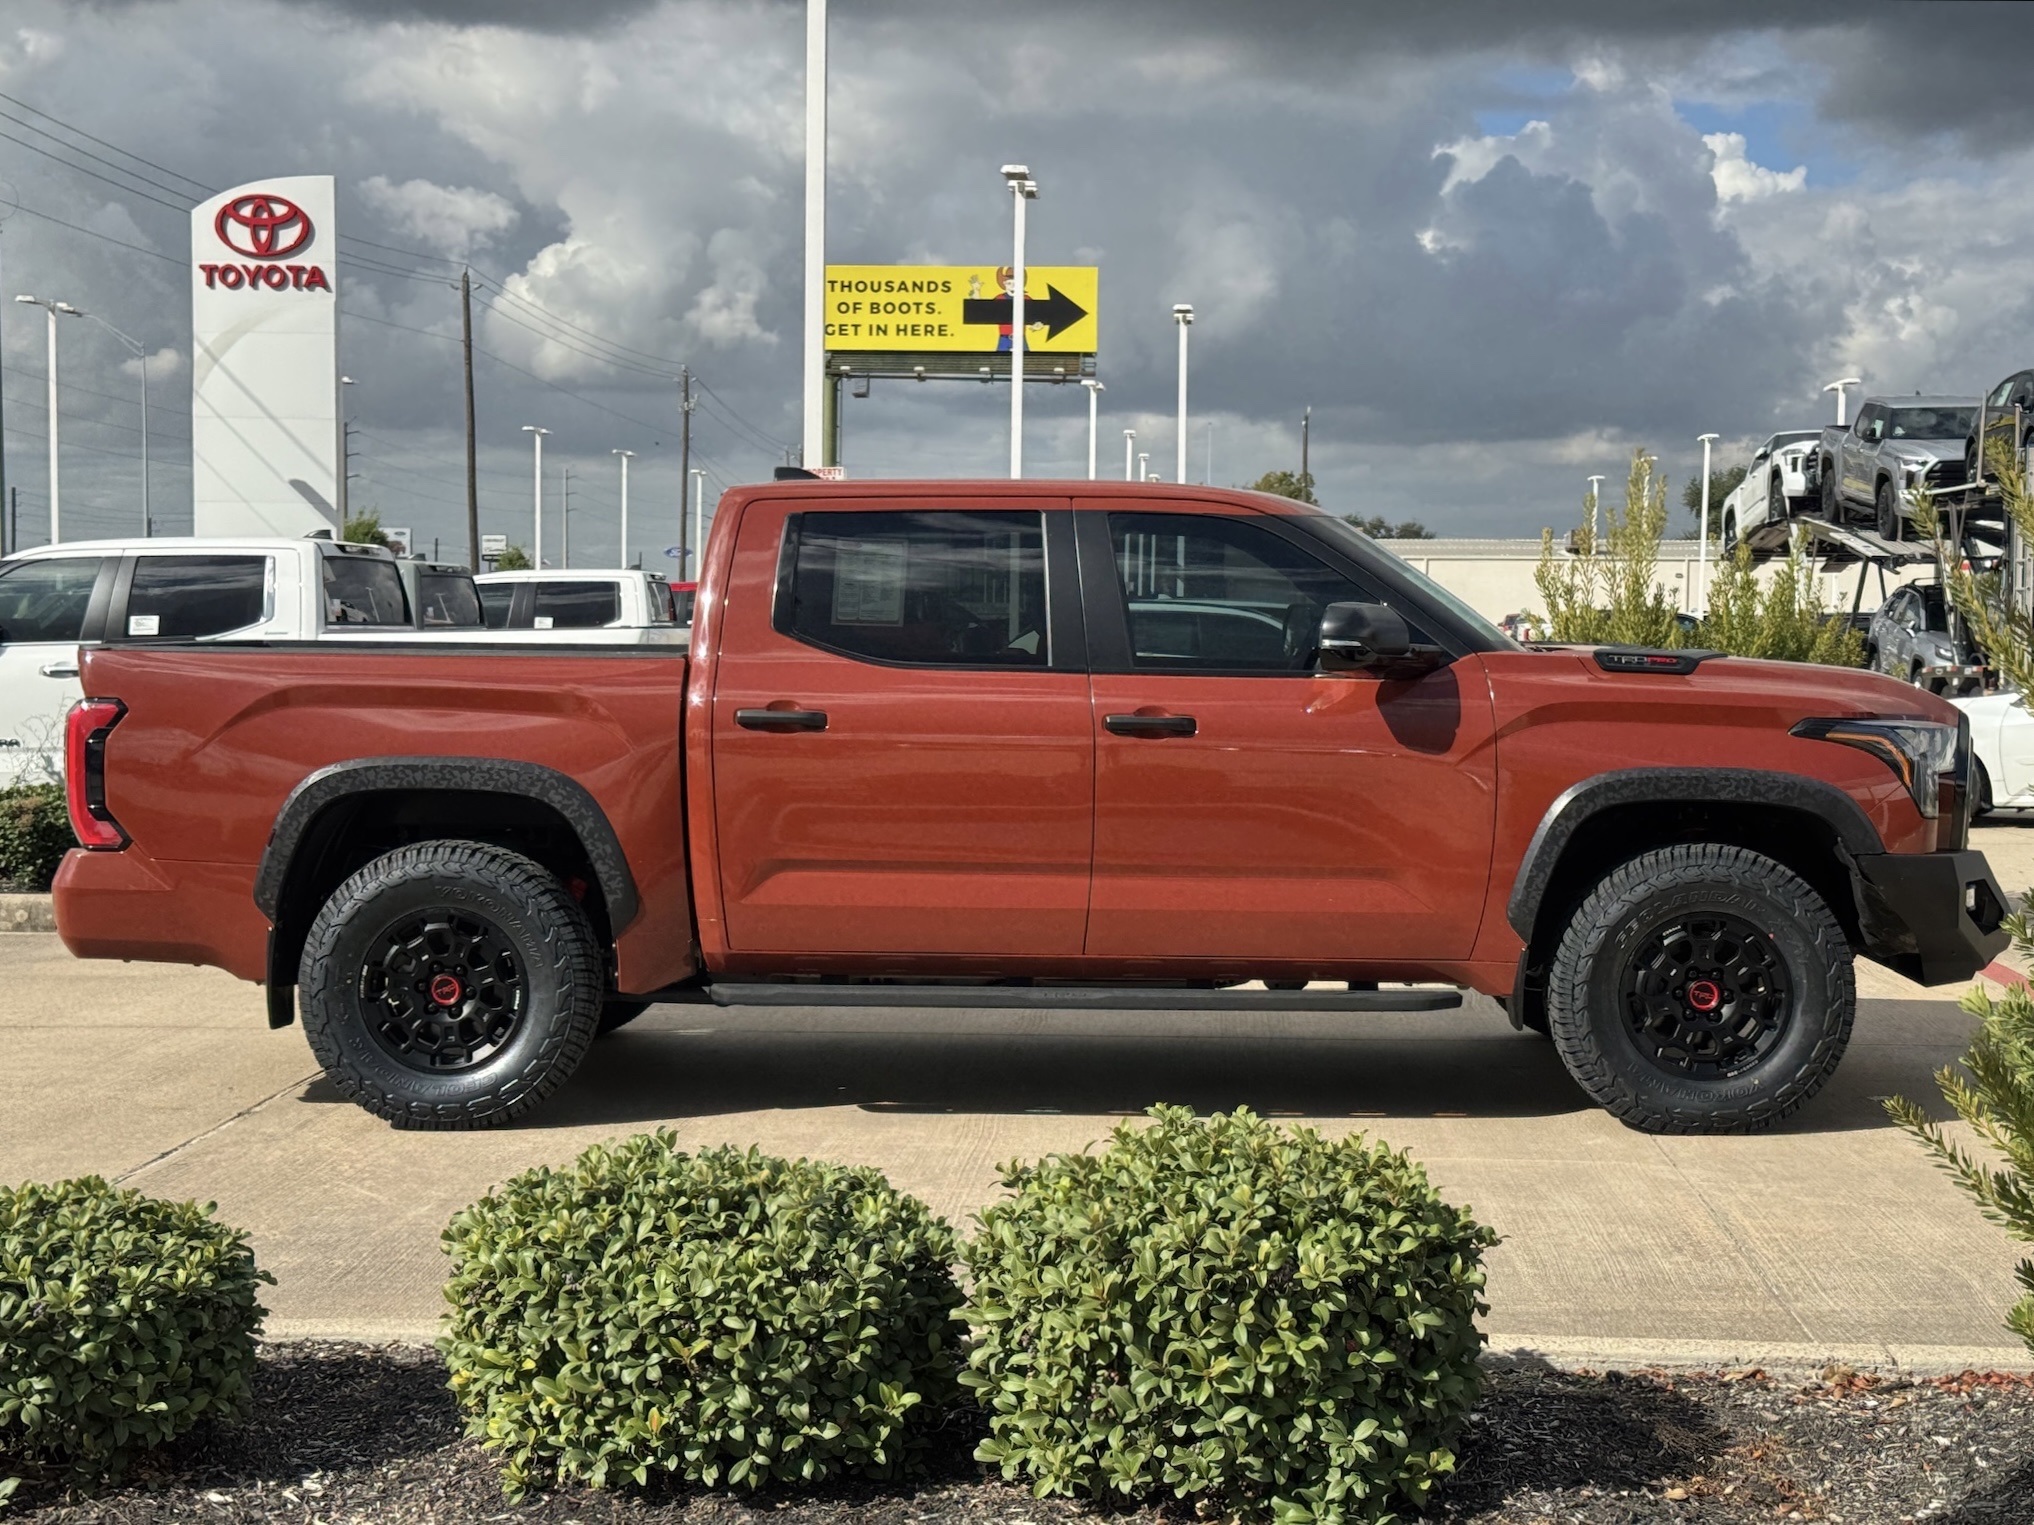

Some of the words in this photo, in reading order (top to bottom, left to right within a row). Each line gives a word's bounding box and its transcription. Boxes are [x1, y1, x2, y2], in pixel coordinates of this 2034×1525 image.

[199, 264, 329, 290] TOYOTA
[827, 280, 952, 293] THOUSANDS
[837, 302, 863, 315] OF
[870, 302, 942, 315] BOOTS.
[824, 323, 862, 337] GET
[869, 324, 887, 337] IN
[896, 324, 955, 338] HERE.
